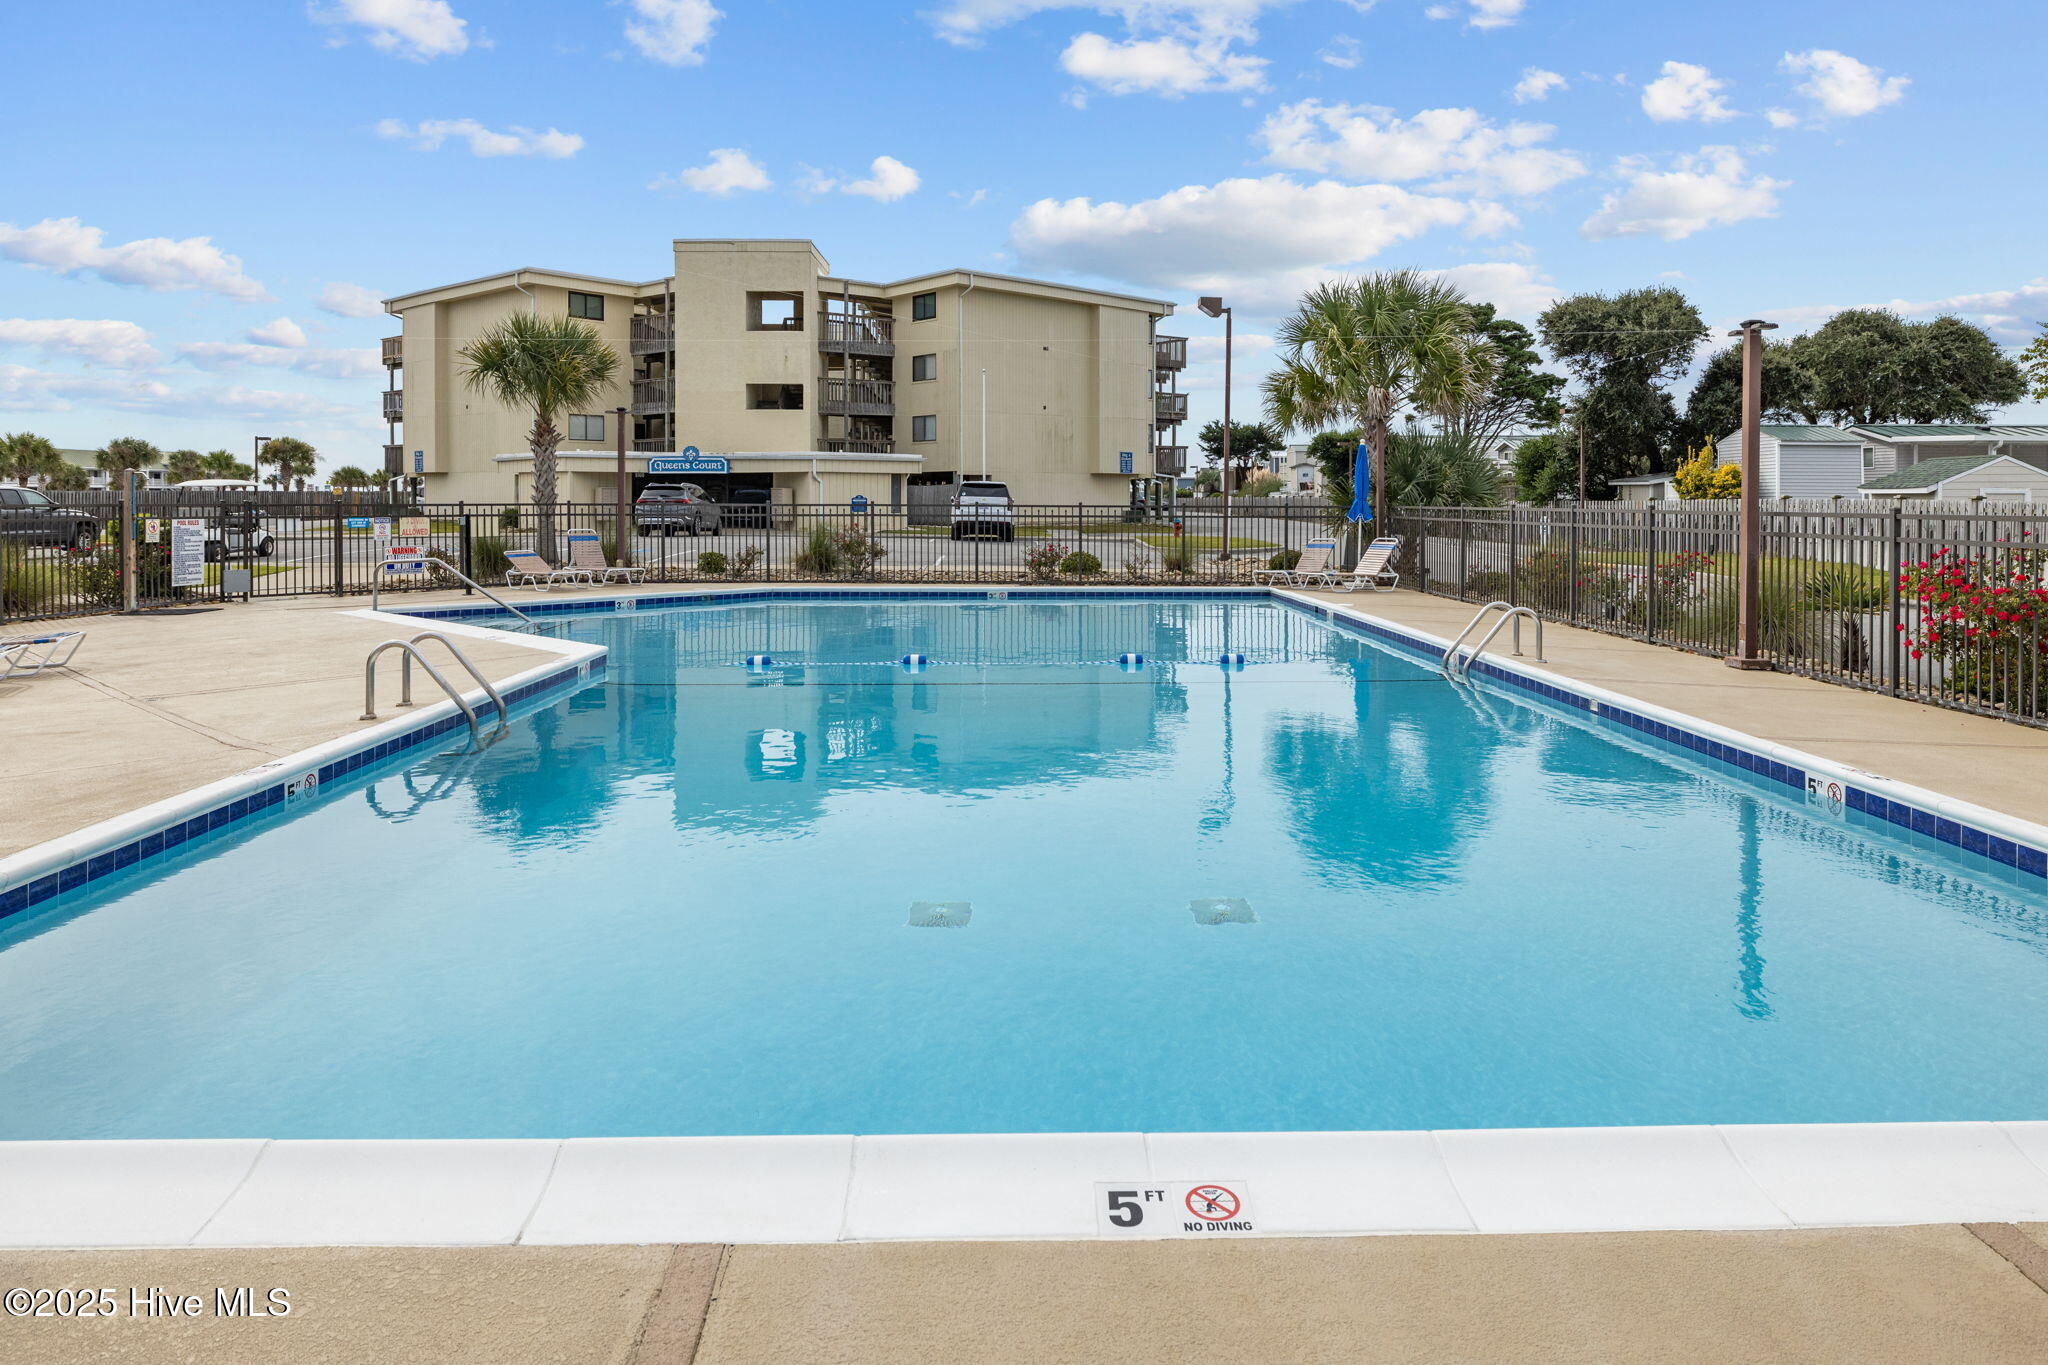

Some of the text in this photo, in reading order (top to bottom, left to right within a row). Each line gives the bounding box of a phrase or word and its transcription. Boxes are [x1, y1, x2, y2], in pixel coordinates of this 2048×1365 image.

[654, 461, 722, 471] Queens Court
[401, 528, 429, 536] ALLOWED
[287, 783, 296, 797] 5
[1808, 777, 1817, 794] 5
[1107, 1190, 1165, 1228] 5 FT
[1184, 1221, 1253, 1232] NO DIVING
